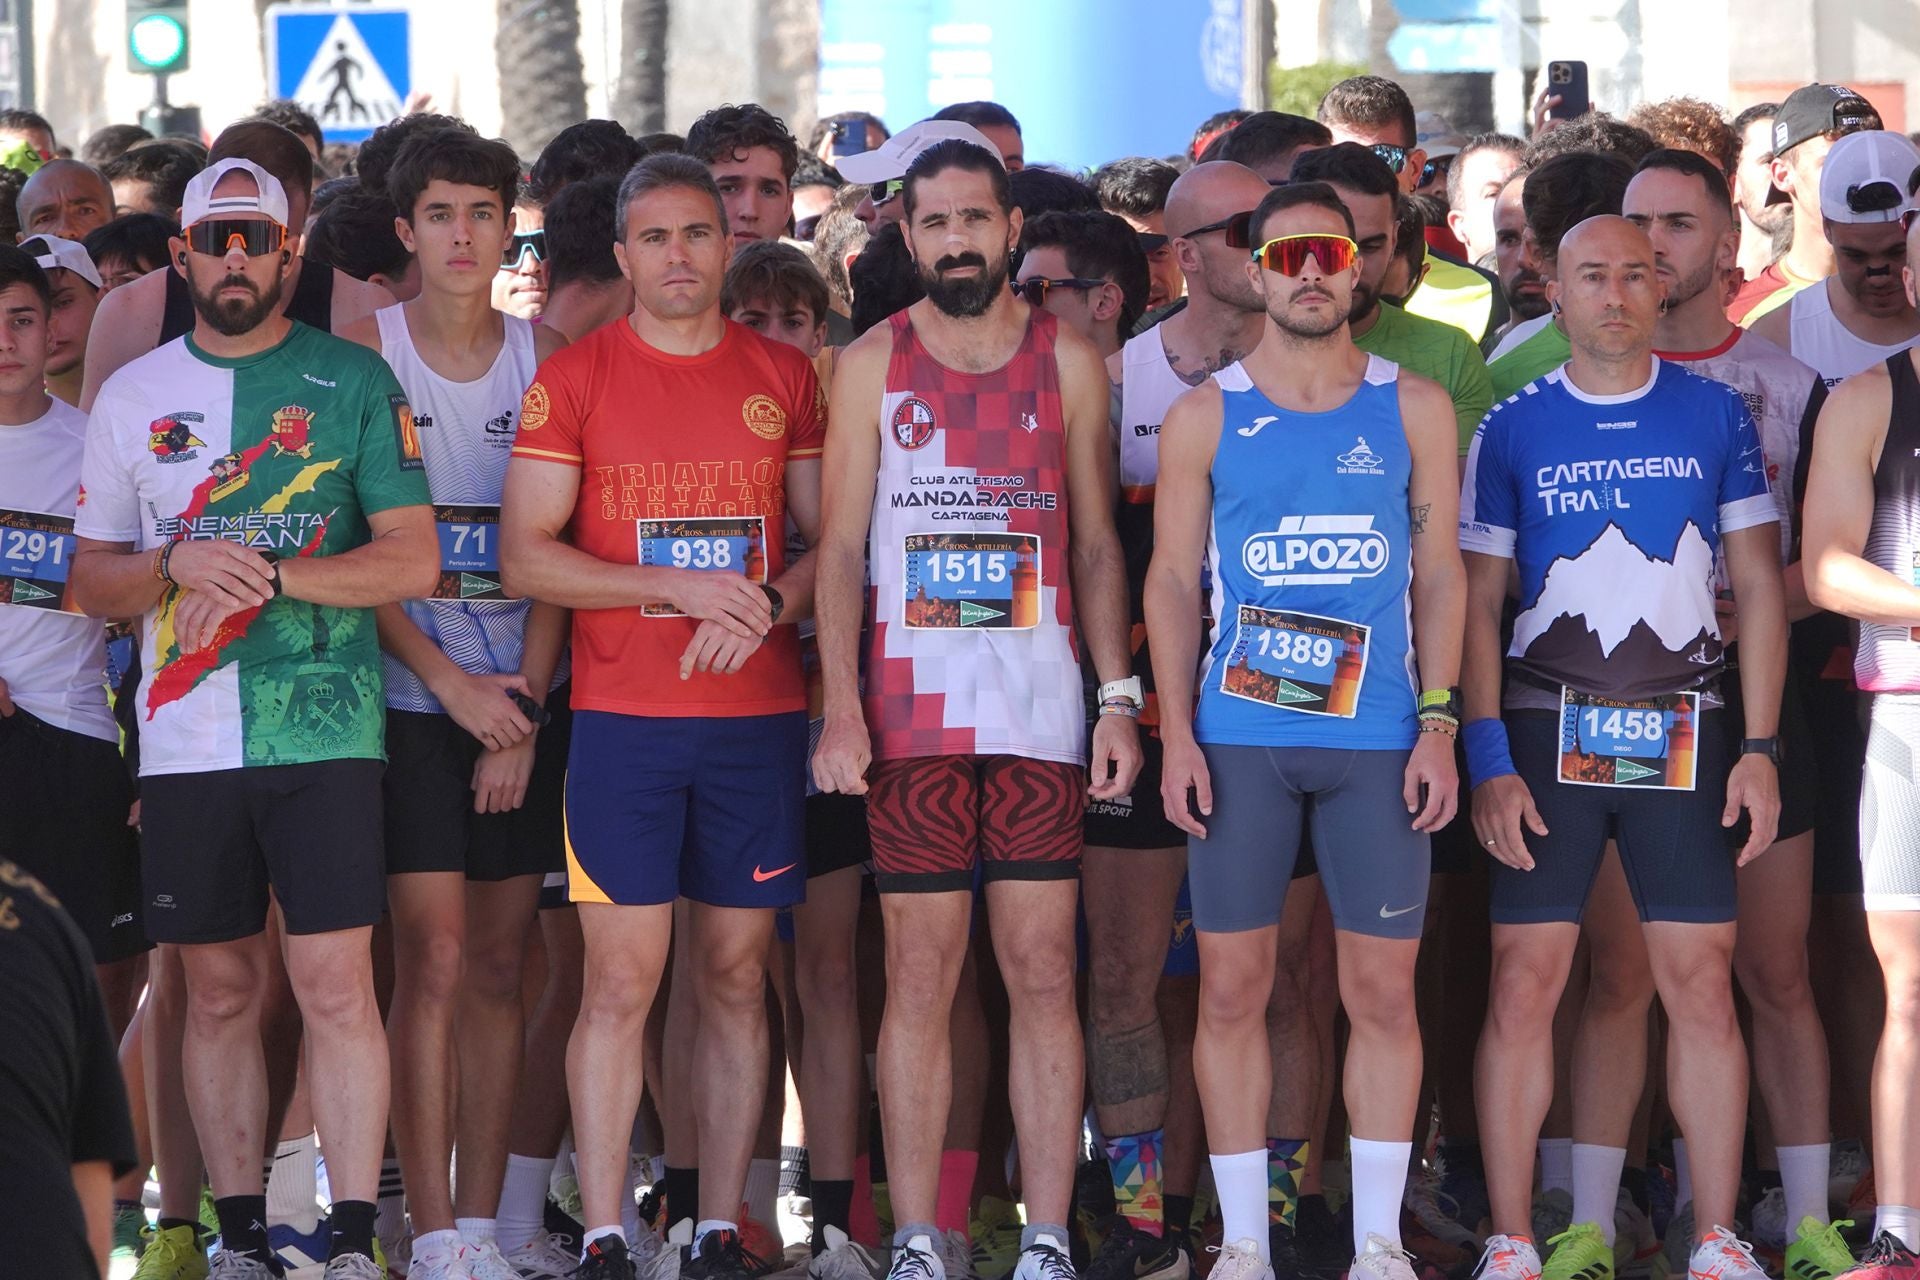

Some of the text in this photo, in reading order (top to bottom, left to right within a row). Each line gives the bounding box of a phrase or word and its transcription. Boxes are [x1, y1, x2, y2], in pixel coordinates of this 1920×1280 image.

[910, 476, 1024, 486] CLUB ATLETISMO
[1537, 456, 1704, 488] CARTAGENA
[602, 487, 716, 503] SANTA
[891, 490, 1057, 510] MANDARACHE
[155, 508, 325, 537] BENEMÉRITA
[931, 511, 1012, 522] CARTAGENA
[451, 525, 487, 554] 71
[680, 529, 704, 537] CROSS
[671, 539, 731, 569] 938
[945, 543, 969, 551] CROSS
[974, 542, 1012, 551] ARTILLERÍA
[926, 552, 1007, 583] 1515
[1274, 620, 1298, 631] CROSS
[1303, 625, 1342, 639] ARTILLERÍA
[1257, 629, 1334, 668] 1389
[1603, 700, 1628, 708] CROSS
[1584, 708, 1663, 741] 1458
[1099, 804, 1133, 817] SPORT
